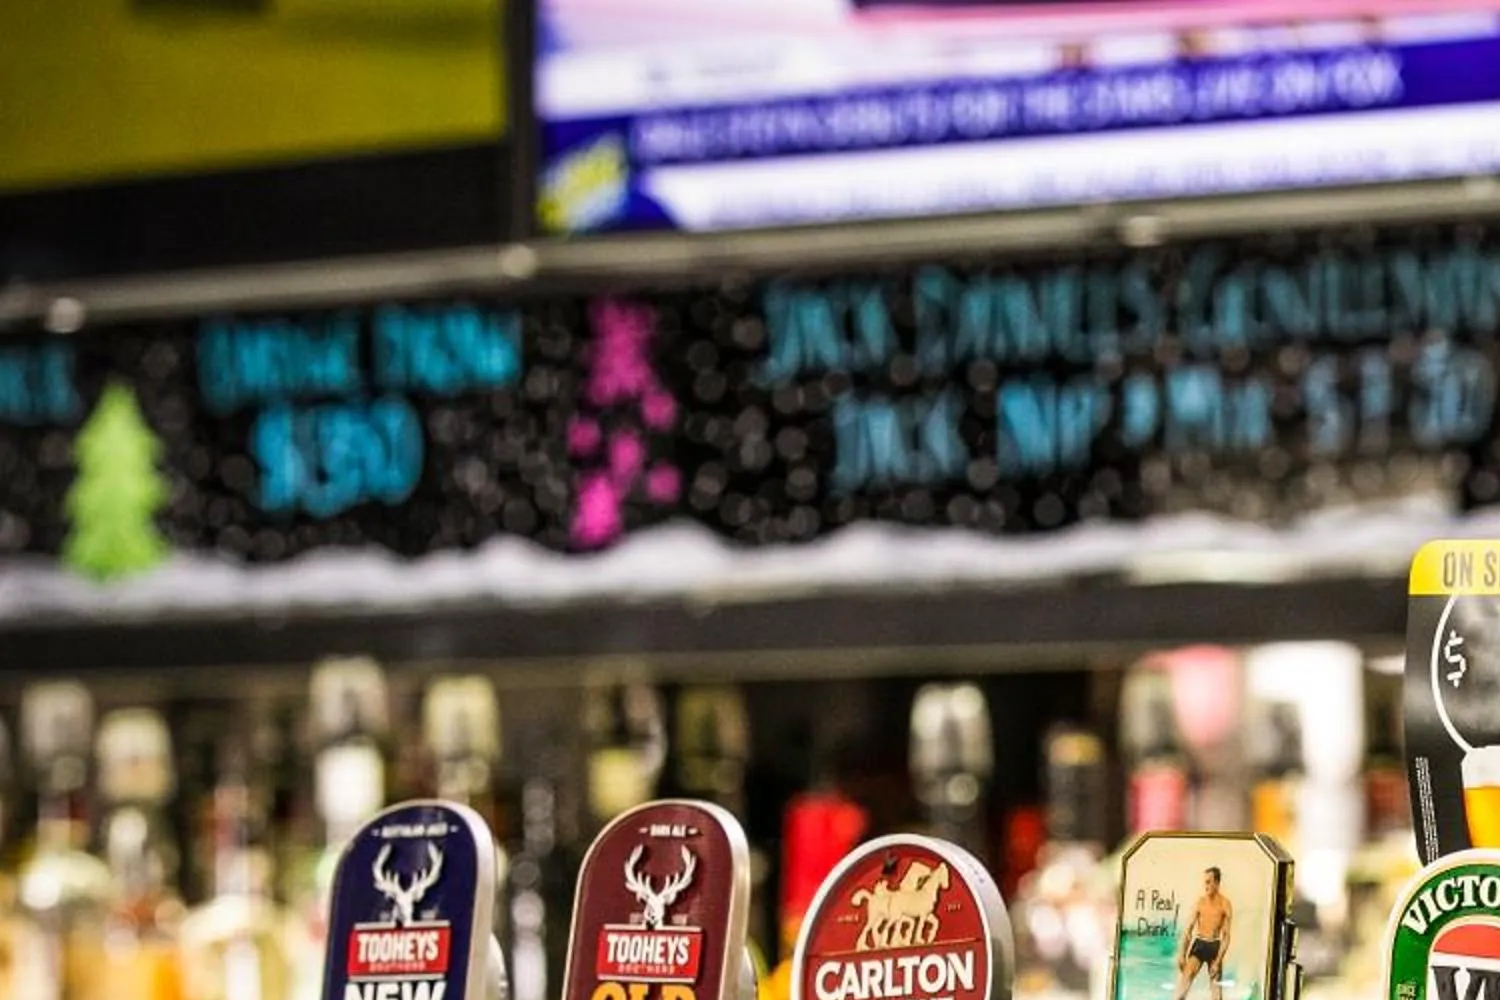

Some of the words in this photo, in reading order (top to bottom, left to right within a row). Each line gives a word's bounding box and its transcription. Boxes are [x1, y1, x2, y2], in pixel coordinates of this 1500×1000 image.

[1442, 551, 1474, 588] ON
[1135, 889, 1146, 911] A
[358, 931, 439, 963] TOOHEYS
[606, 933, 690, 965] TOOHEYS
